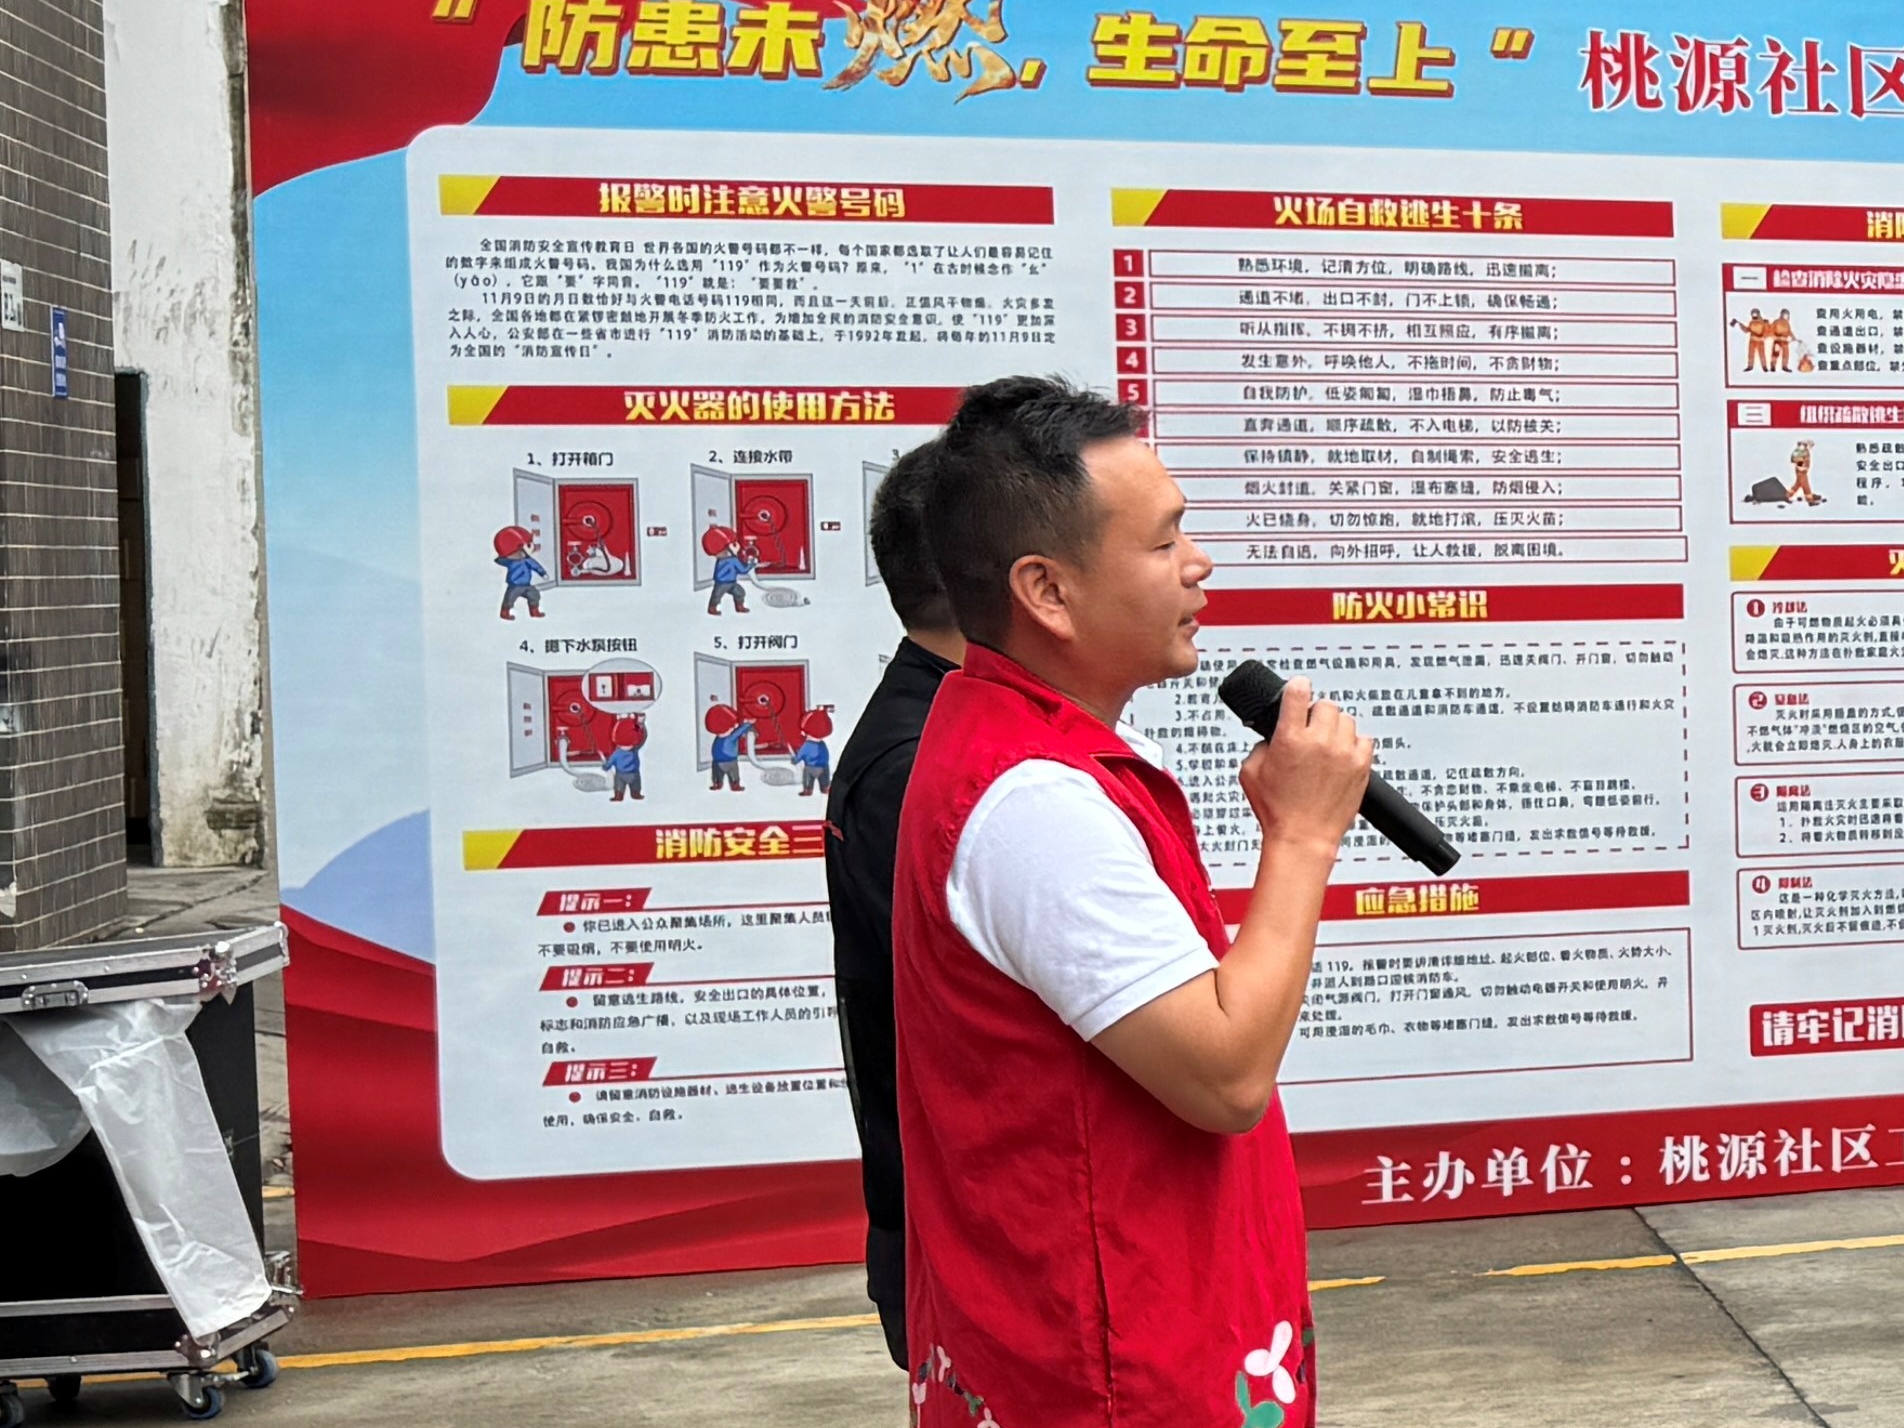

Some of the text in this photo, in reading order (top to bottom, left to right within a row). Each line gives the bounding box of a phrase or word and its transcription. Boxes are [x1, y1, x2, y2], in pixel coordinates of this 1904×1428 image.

[598, 181, 906, 219] 报警时注意火警号码
[1272, 195, 1524, 231] 火场自救逃生十条
[1123, 255, 1133, 270] 1
[1122, 287, 1135, 303] 2
[1125, 319, 1137, 335] 3
[1125, 352, 1138, 368] 4
[1126, 384, 1139, 400] 5
[623, 390, 896, 424] 灭火器的使用方法
[1332, 590, 1490, 622] 防火小常识
[1355, 884, 1480, 916] 应急措施
